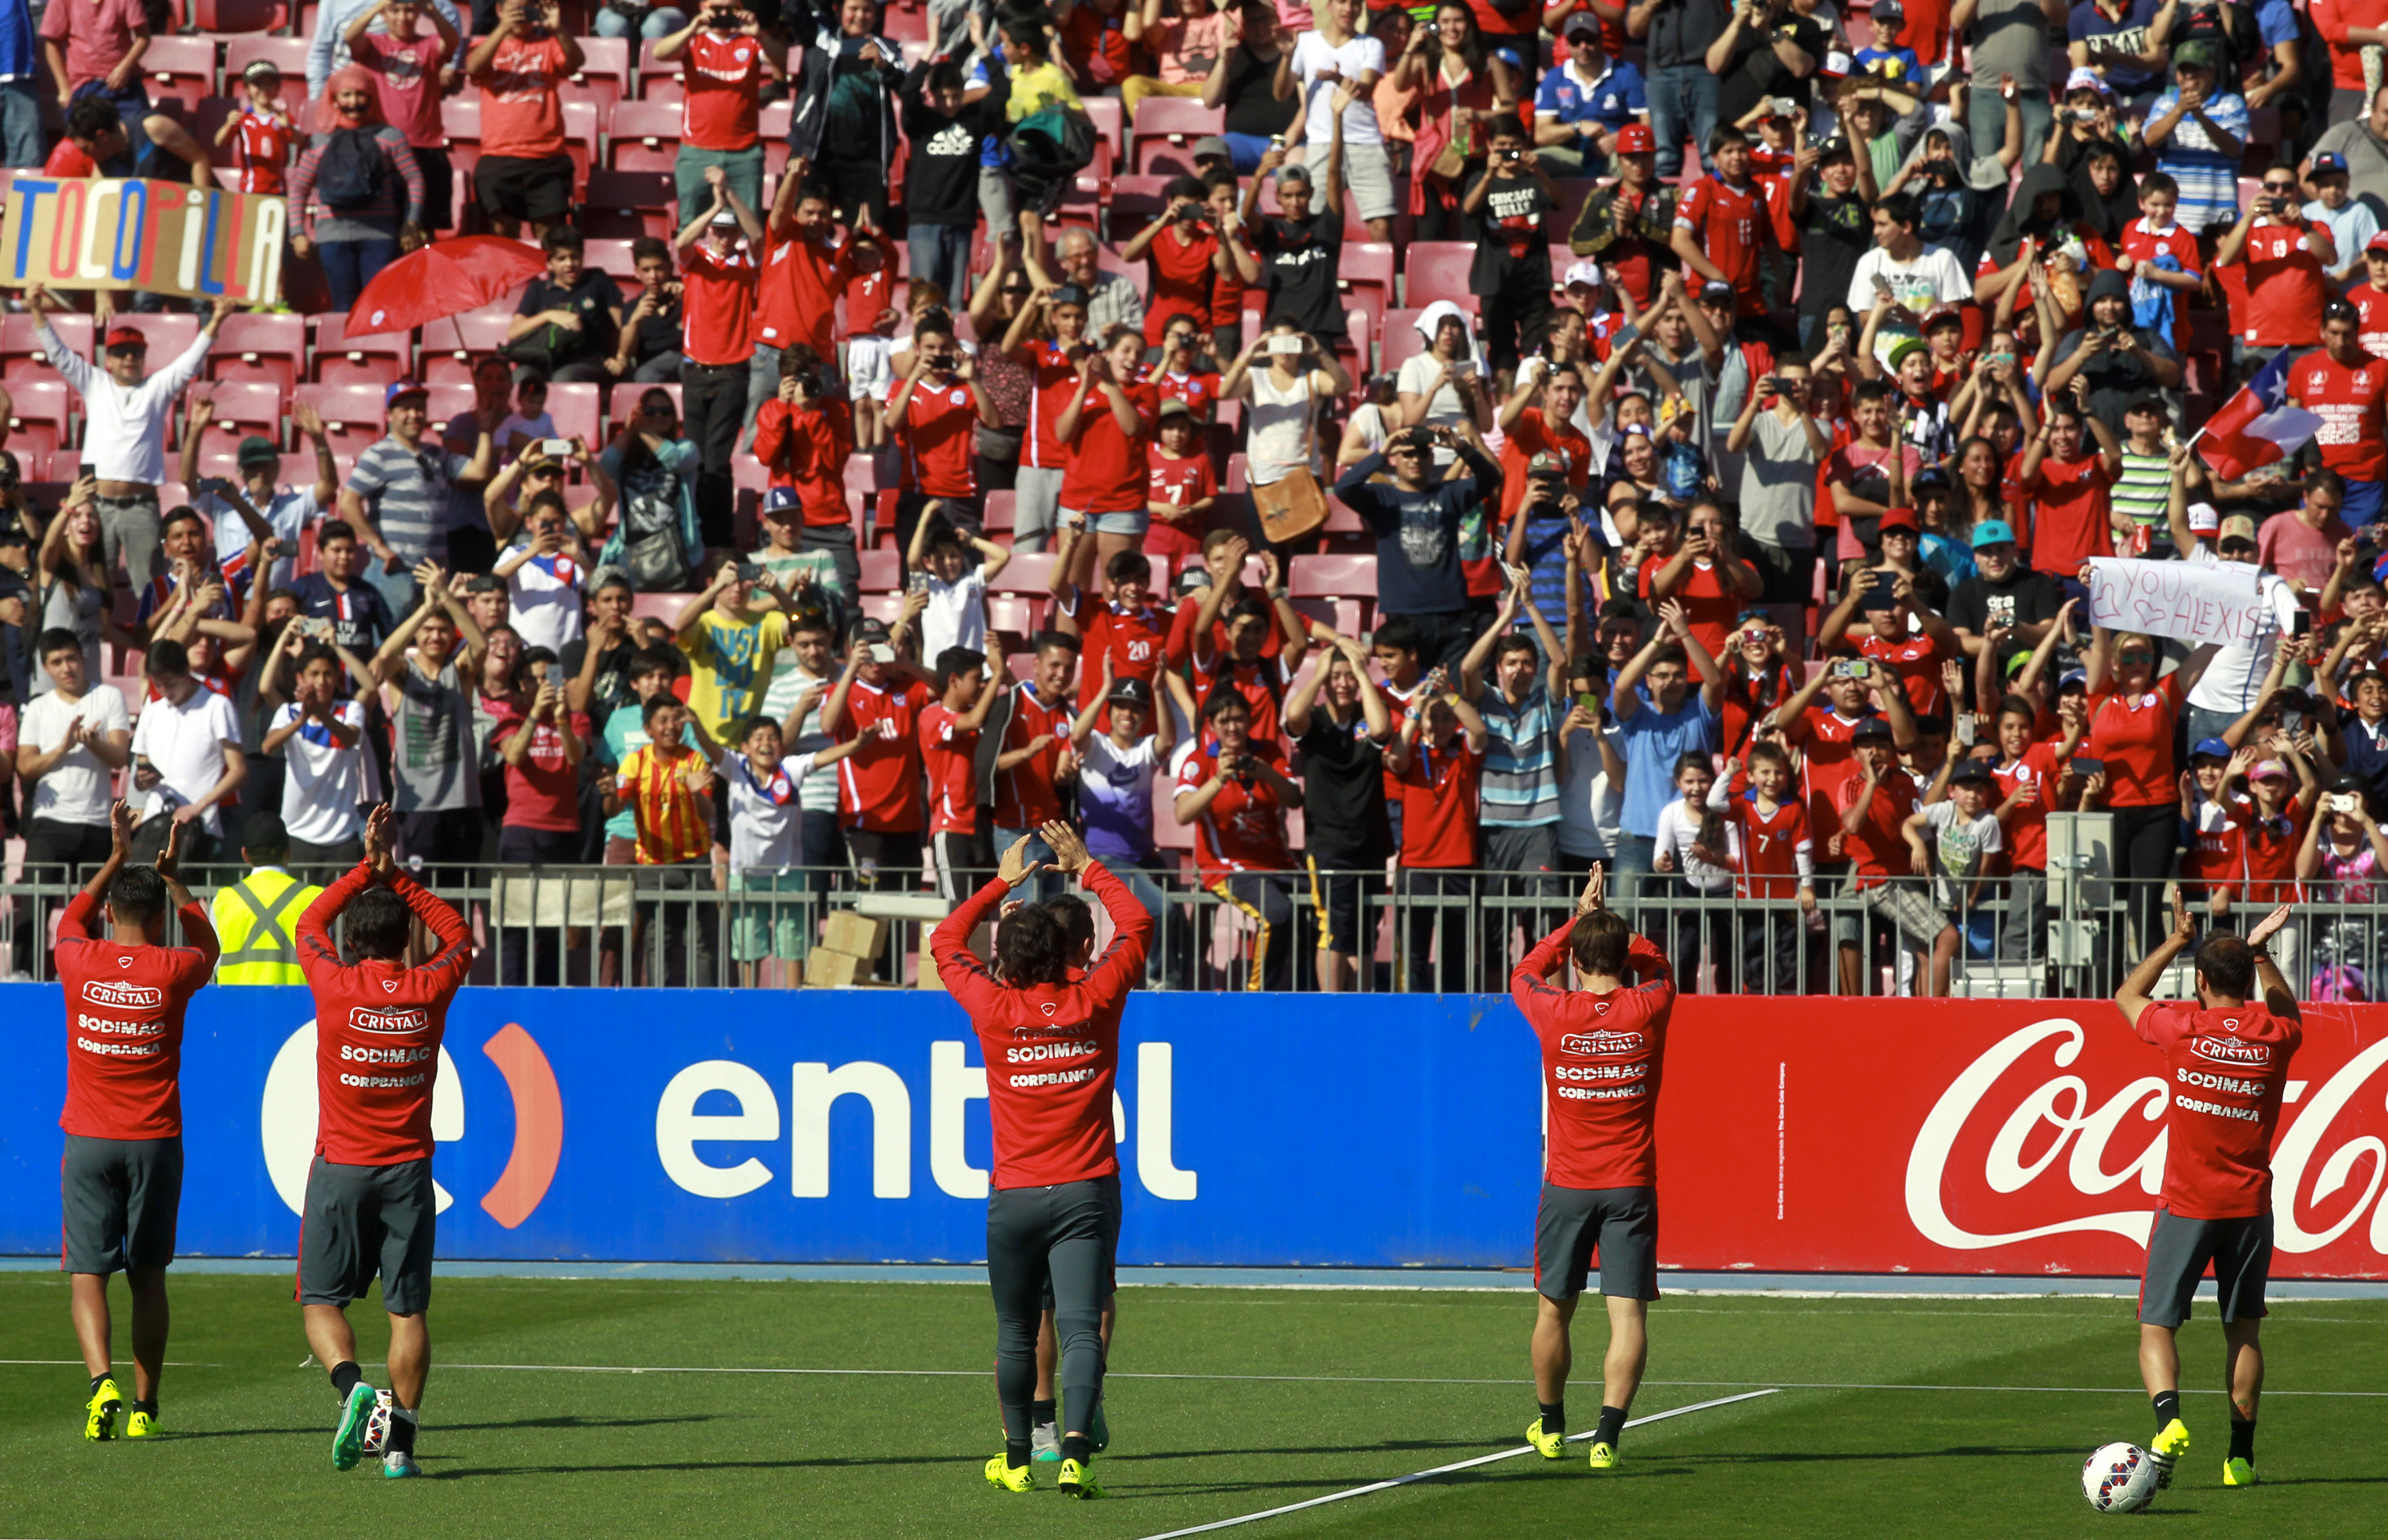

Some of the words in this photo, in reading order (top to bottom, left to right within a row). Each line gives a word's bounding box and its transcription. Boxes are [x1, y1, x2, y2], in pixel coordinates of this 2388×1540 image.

[862, 280, 873, 296] 7
[1165, 484, 1183, 505] 7
[2115, 560, 2182, 602] YOU
[2169, 592, 2262, 639] ALEXIS
[1127, 640, 1150, 662] 20
[1757, 833, 1770, 854] 7
[90, 986, 156, 1005] CRISTAL
[78, 1014, 165, 1036] SODIMAC
[357, 1013, 423, 1030] CRISTAL
[77, 1036, 161, 1055] CORPBANCA
[341, 1045, 431, 1063] SODIMAC
[1006, 1040, 1097, 1063] SODIMAC
[1569, 1037, 1638, 1053] CRISTAL
[2200, 1040, 2264, 1061] CRISTAL
[340, 1073, 425, 1087] CORPBANCA
[1010, 1068, 1096, 1087] CORPBANCA
[1555, 1063, 1649, 1080] SODIMAC
[2177, 1067, 2265, 1096] SODIMAC
[1558, 1084, 1646, 1099] CORPBANCA
[2175, 1095, 2259, 1122] CORPBANCA
[656, 1041, 1197, 1201] entl
